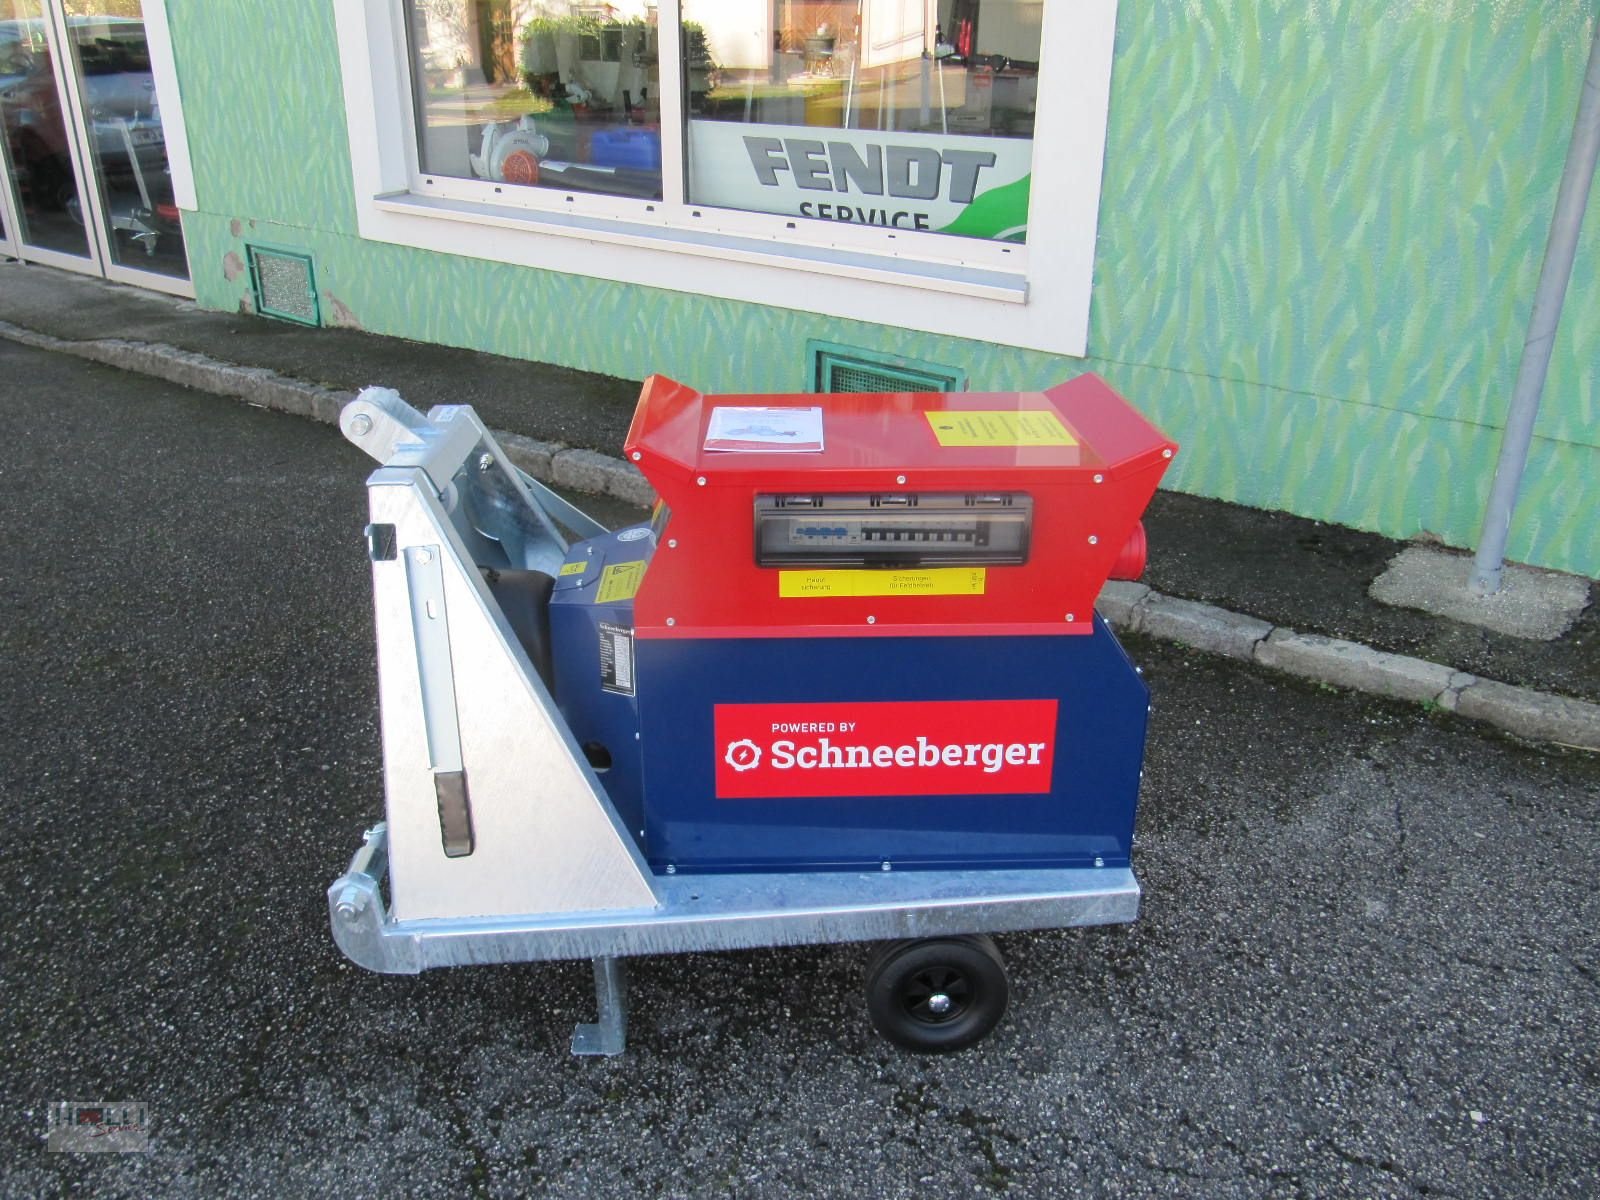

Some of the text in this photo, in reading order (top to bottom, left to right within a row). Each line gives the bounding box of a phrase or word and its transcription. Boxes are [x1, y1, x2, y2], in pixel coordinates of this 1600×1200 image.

[743, 136, 997, 204] FENDT
[771, 722, 856, 733] POWERED BY
[771, 736, 1045, 773] Schneeberger
